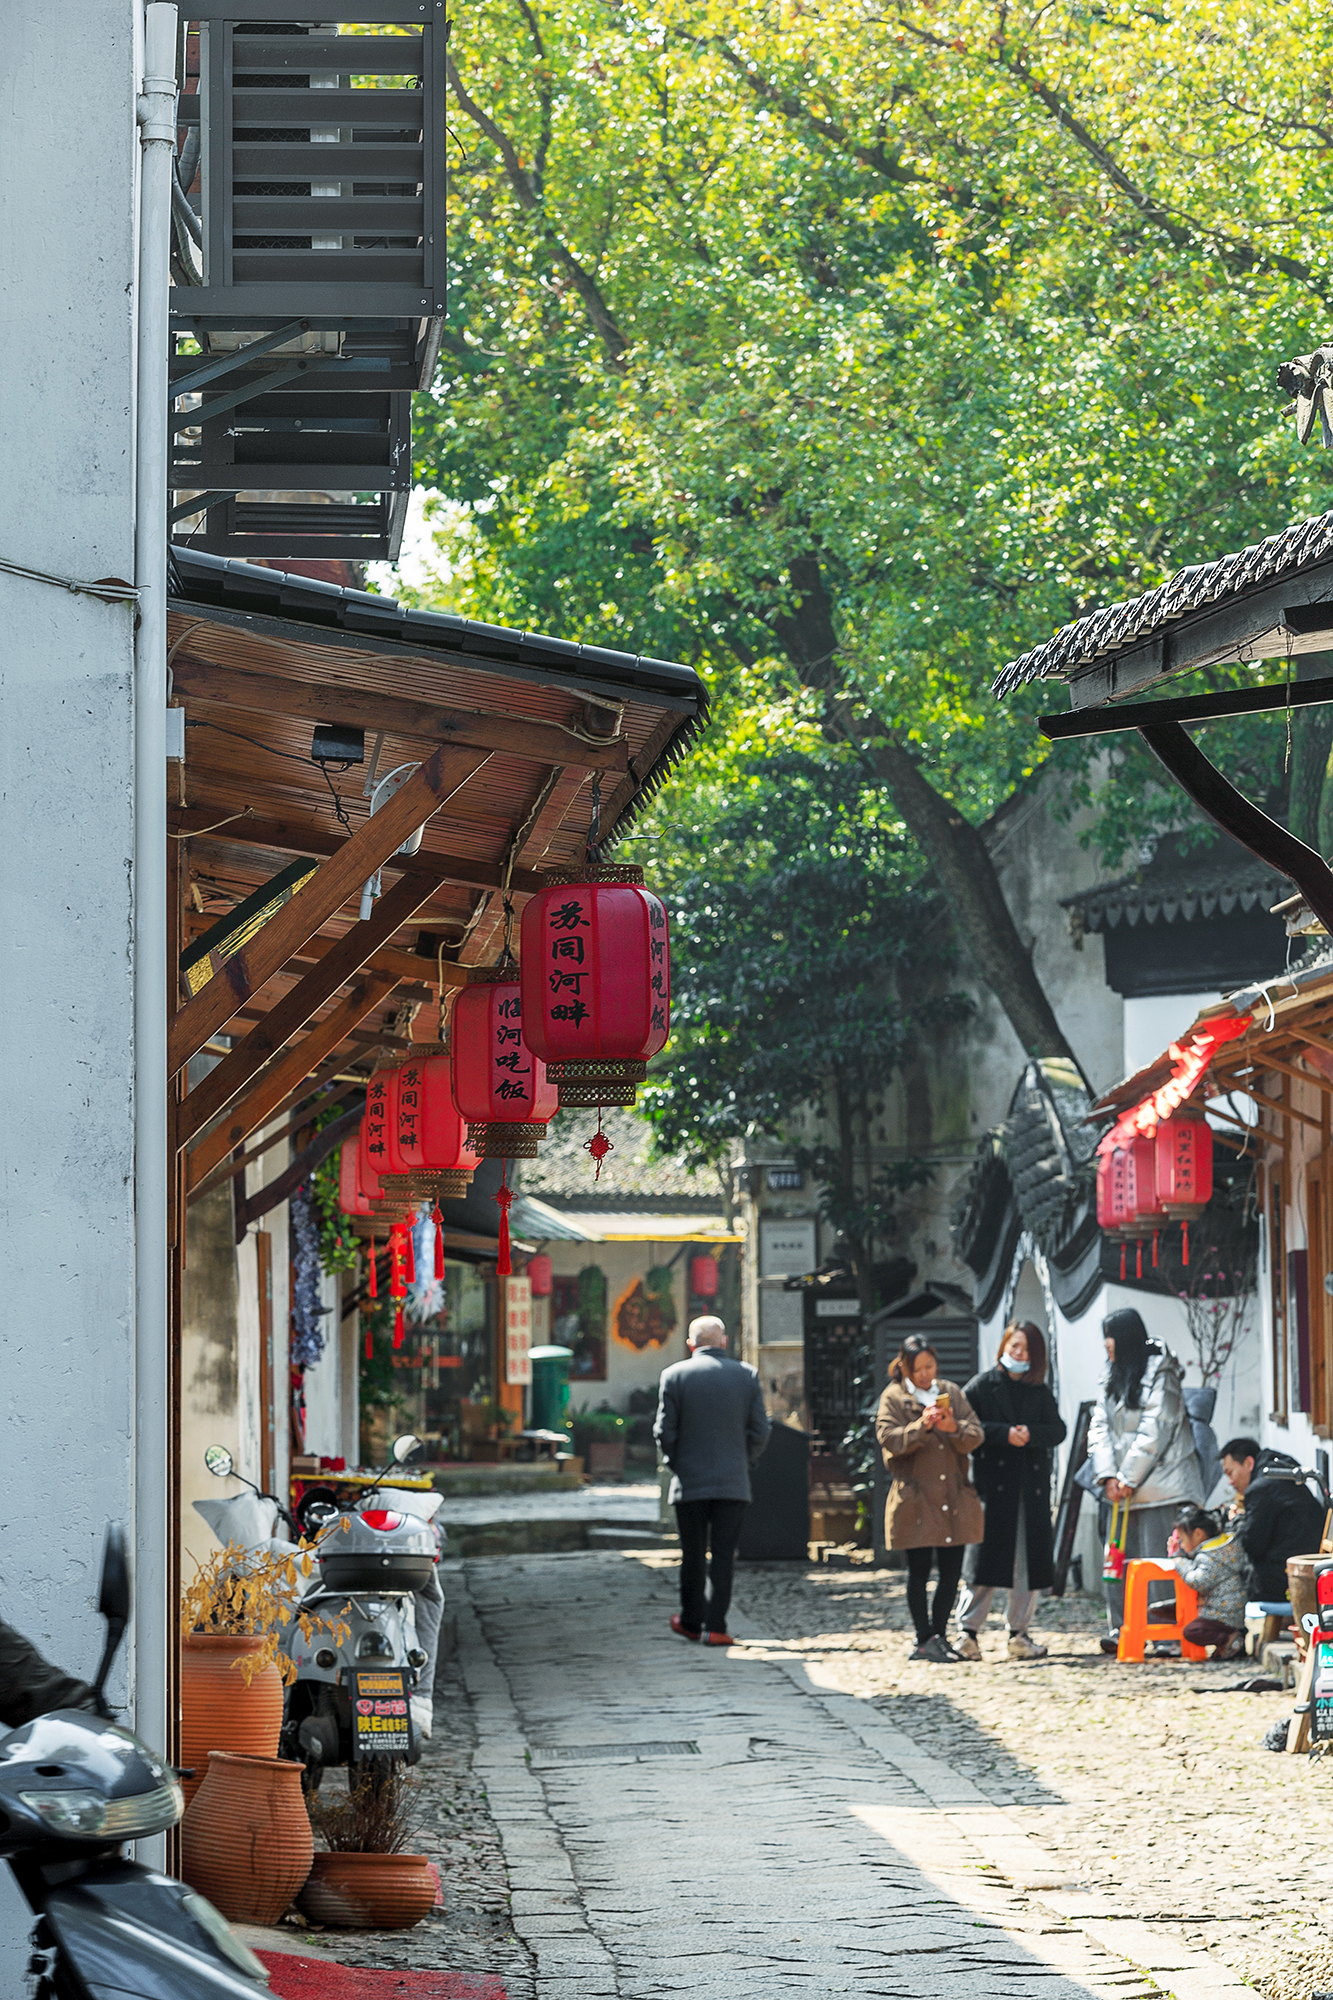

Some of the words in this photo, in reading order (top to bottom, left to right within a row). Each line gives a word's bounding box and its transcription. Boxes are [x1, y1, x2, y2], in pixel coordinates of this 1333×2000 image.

[549, 901, 591, 1030] 苏同河畔
[650, 903, 668, 1032] 临河吃饭
[494, 997, 531, 1100] 临河吃饭
[367, 1082, 388, 1158] 苏同河畔
[399, 1068, 422, 1151] 苏同河畔
